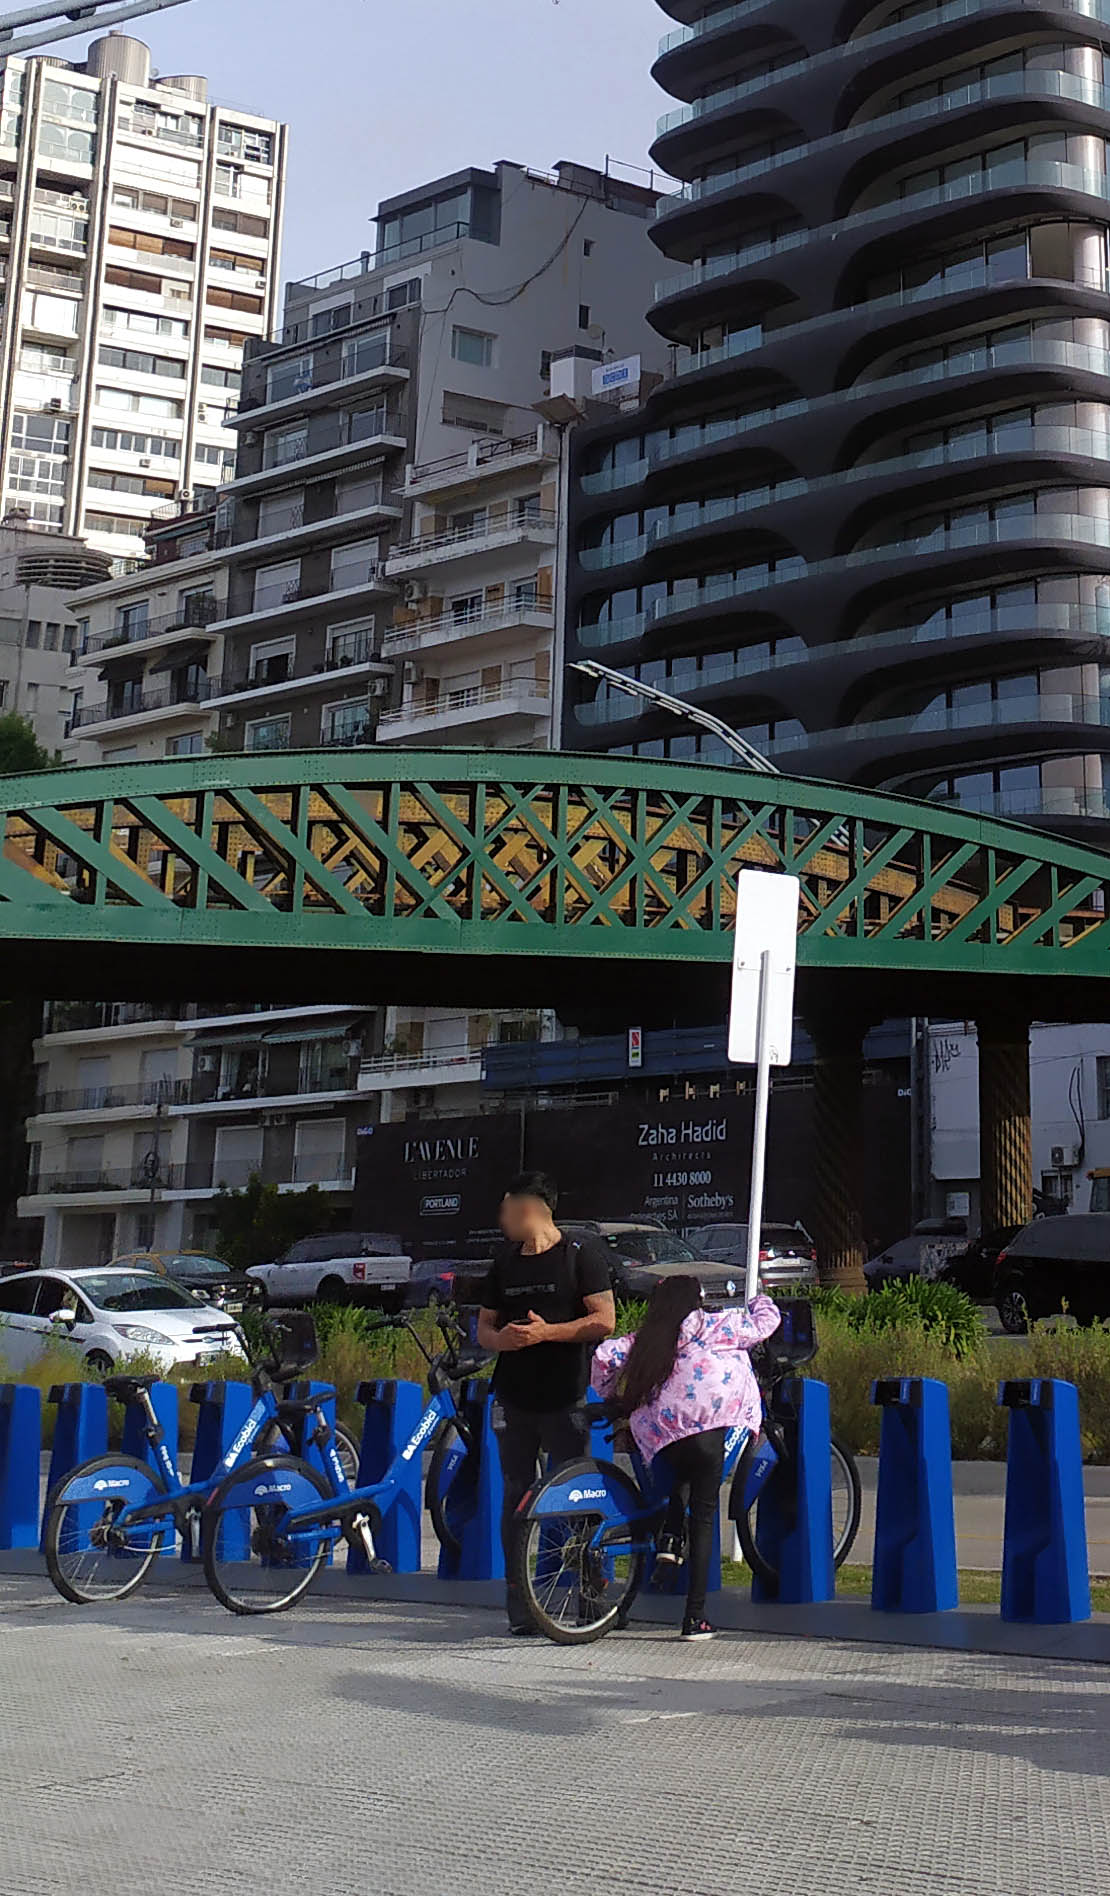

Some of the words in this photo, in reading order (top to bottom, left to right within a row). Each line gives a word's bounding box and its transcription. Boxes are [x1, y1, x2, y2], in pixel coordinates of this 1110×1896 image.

[638, 1123, 677, 1146] Zaha
[681, 1118, 727, 1143] Hadid
[653, 1173, 663, 1187] 11
[665, 1172, 688, 1186] 4430
[689, 1170, 711, 1185] 8000
[425, 1197, 458, 1209] PORTLAND
[644, 1195, 679, 1208] Argentina
[687, 1192, 734, 1210] Sotheby's
[233, 1418, 256, 1452] Ecobici
[411, 1409, 437, 1446] Ecobici
[583, 1488, 607, 1499] Macro
